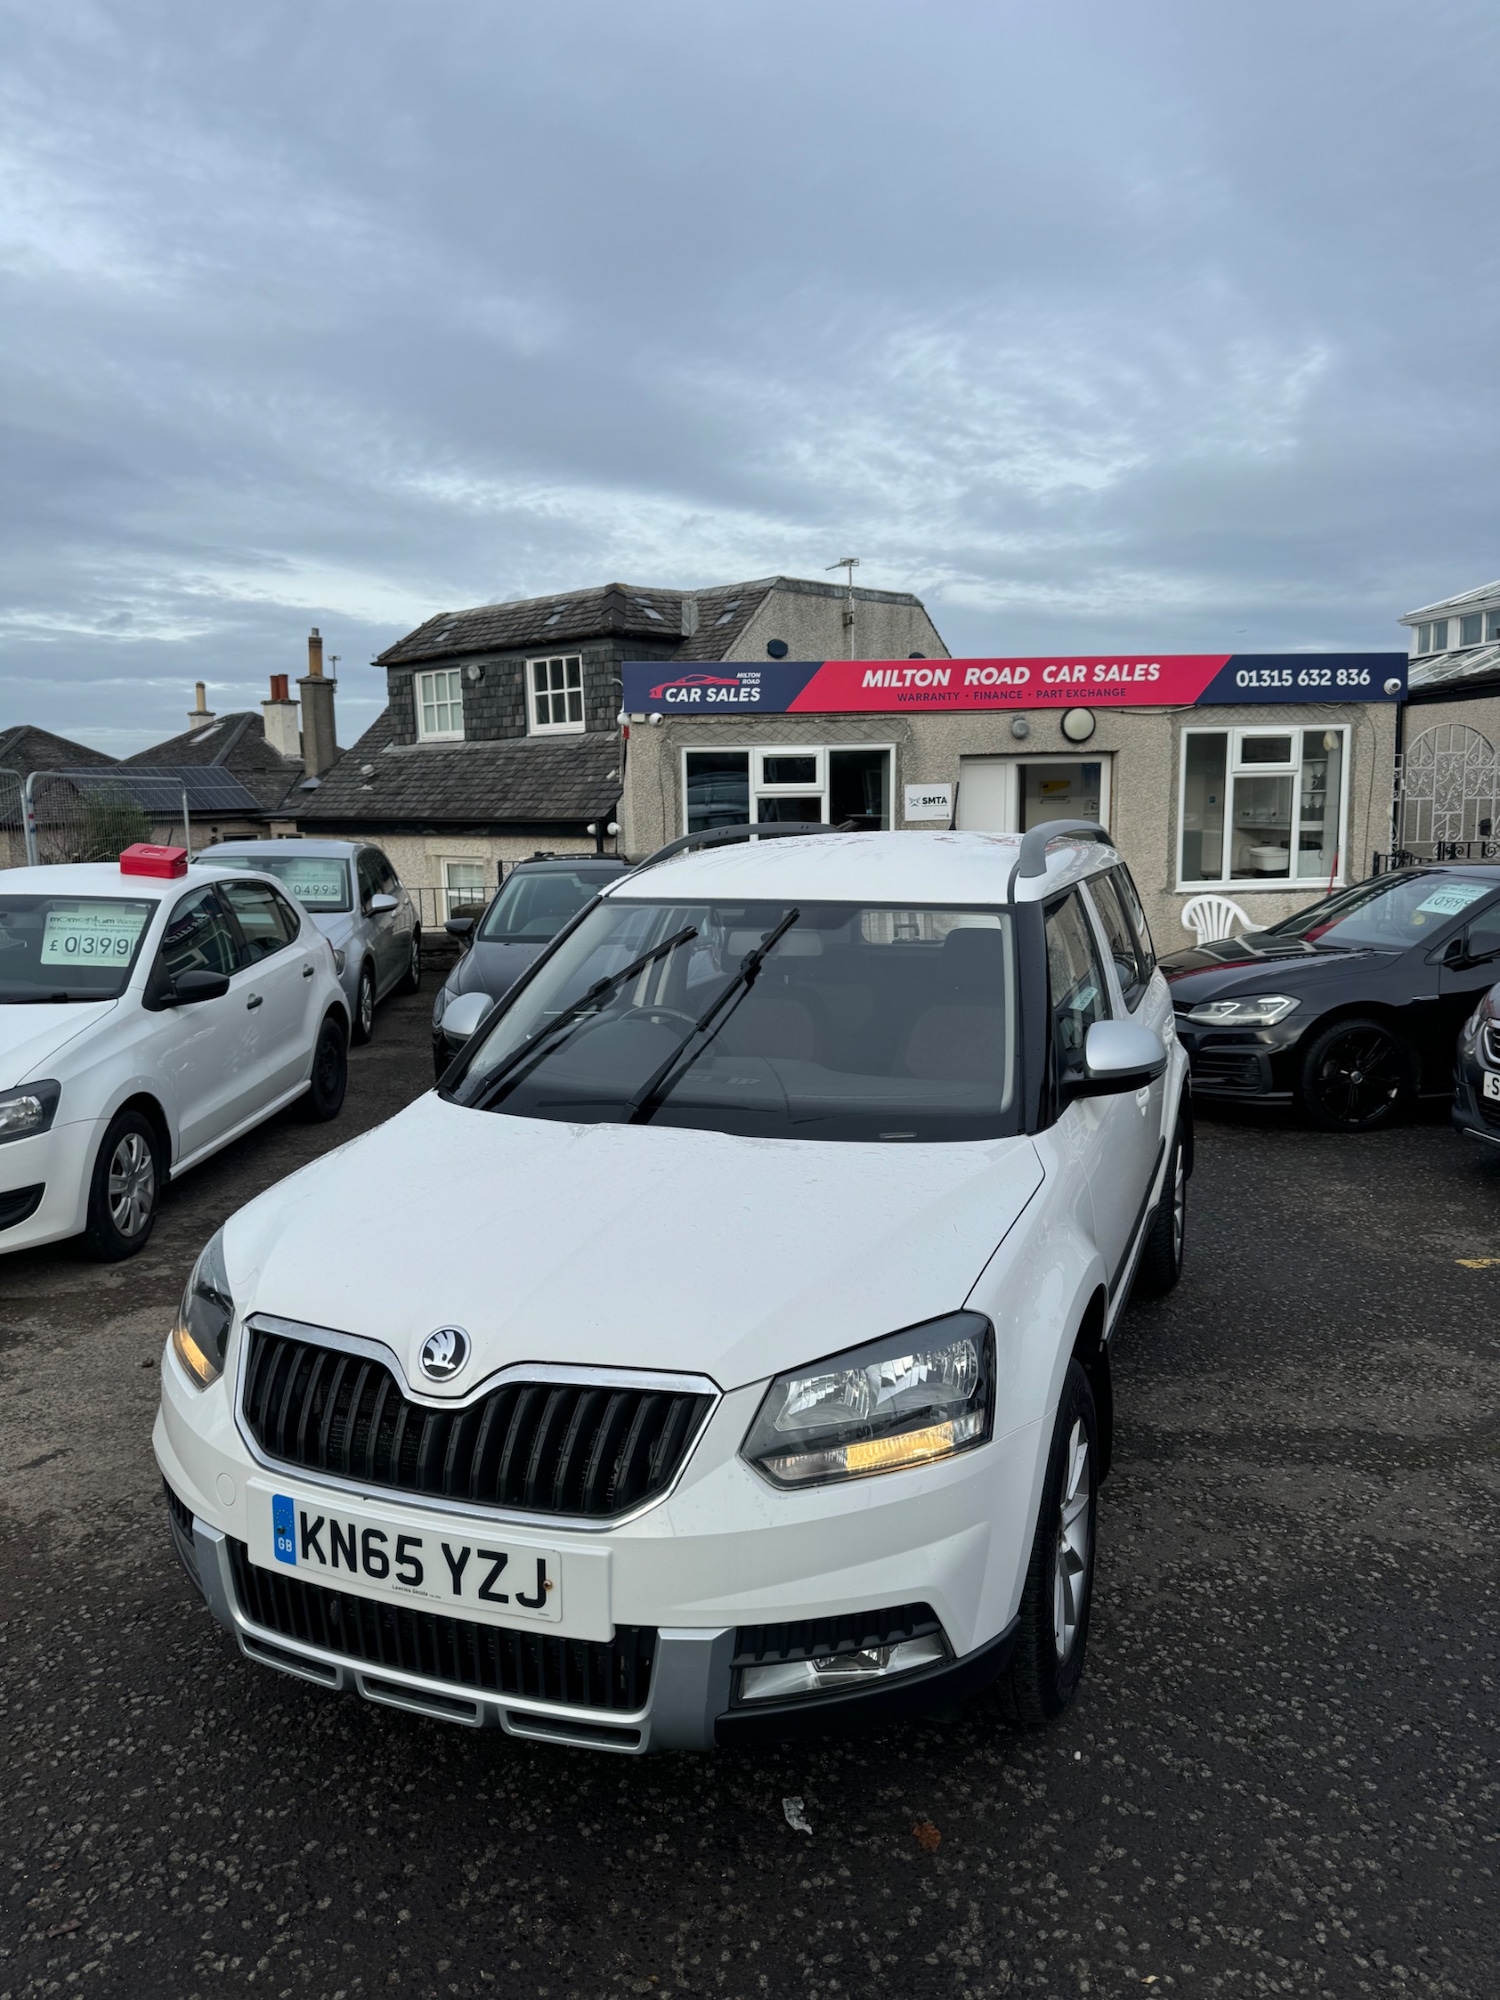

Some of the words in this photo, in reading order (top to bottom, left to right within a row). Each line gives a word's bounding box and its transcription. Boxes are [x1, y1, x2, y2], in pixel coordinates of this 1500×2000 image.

[862, 668, 951, 688] MILTON
[964, 667, 1030, 686] ROAD
[1042, 665, 1087, 683] CAR
[1092, 663, 1160, 682] SALES
[1236, 669, 1293, 687] 01315
[1297, 669, 1332, 686] 632
[1336, 668, 1371, 686] 836
[665, 688, 701, 702] CAR
[706, 688, 761, 702] SALES
[897, 692, 960, 702] WARRANTY
[973, 690, 1023, 700] FINANCE
[1036, 689, 1063, 698] PART
[1066, 688, 1126, 698] EXCHANGE
[922, 796, 948, 805] SMTA
[294, 884, 338, 895] 04995
[49, 940, 58, 951] £
[278, 1536, 292, 1552] GB
[300, 1511, 424, 1587] KN65
[441, 1542, 547, 1609] YZJ
